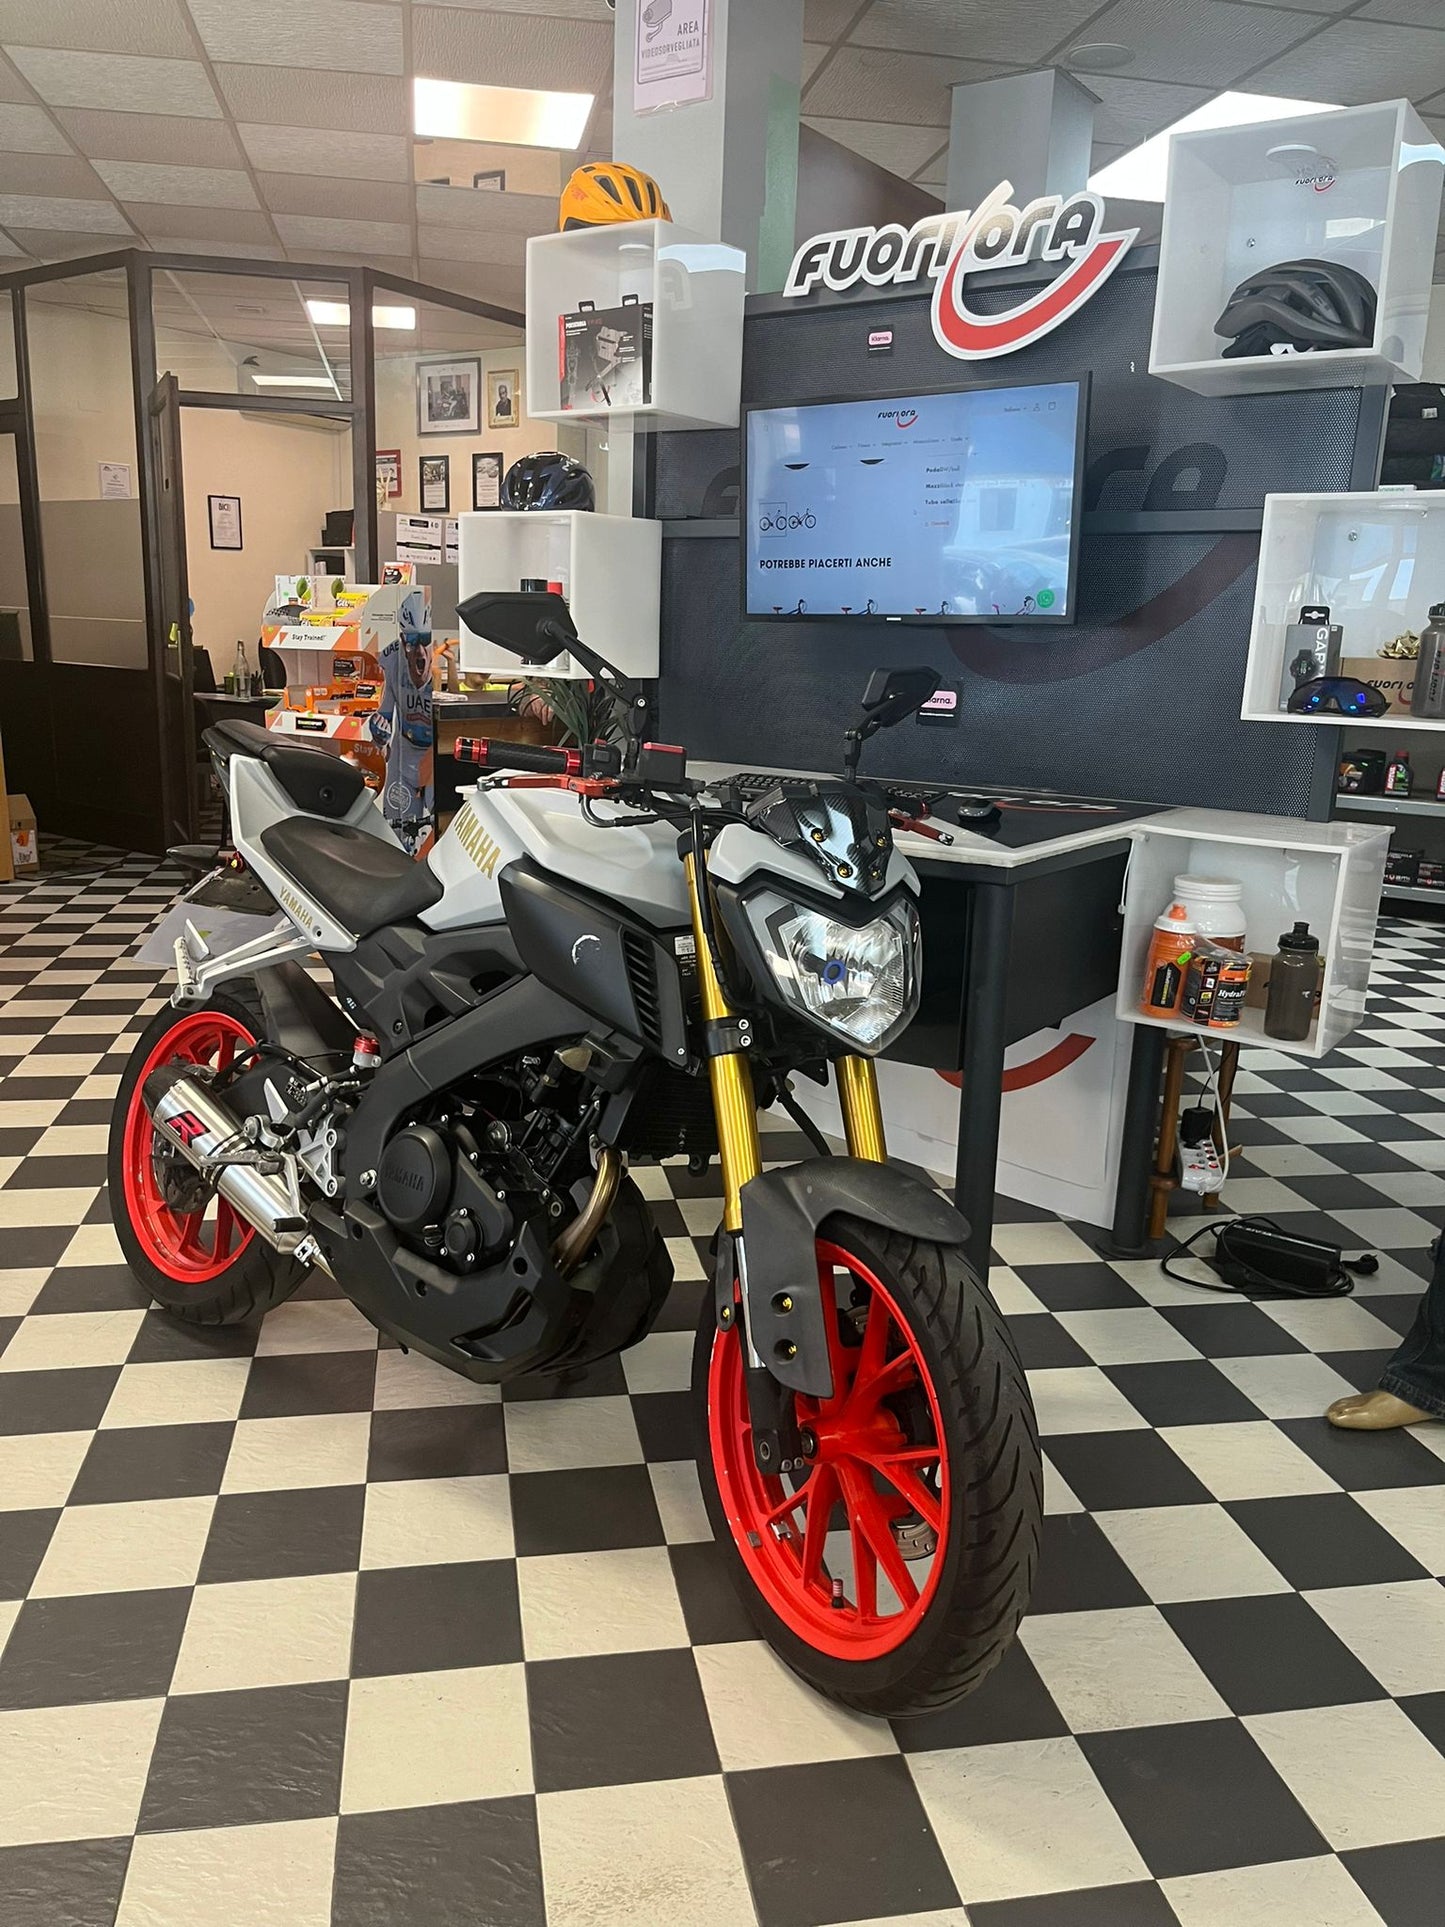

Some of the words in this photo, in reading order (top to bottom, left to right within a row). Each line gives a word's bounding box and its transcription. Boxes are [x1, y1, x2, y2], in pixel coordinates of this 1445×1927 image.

[677, 20, 699, 36] AREA
[641, 38, 700, 59] VIDEOSORVEGLIATA
[759, 558, 806, 569] POTREBBE
[808, 557, 852, 568] PIACERTI
[855, 557, 892, 567] ANCHE
[292, 633, 303, 641] Stay
[383, 641, 399, 657] UAE
[406, 694, 431, 714] UAE
[454, 800, 501, 880] YAMAHA
[280, 886, 313, 929] YAMAHA
